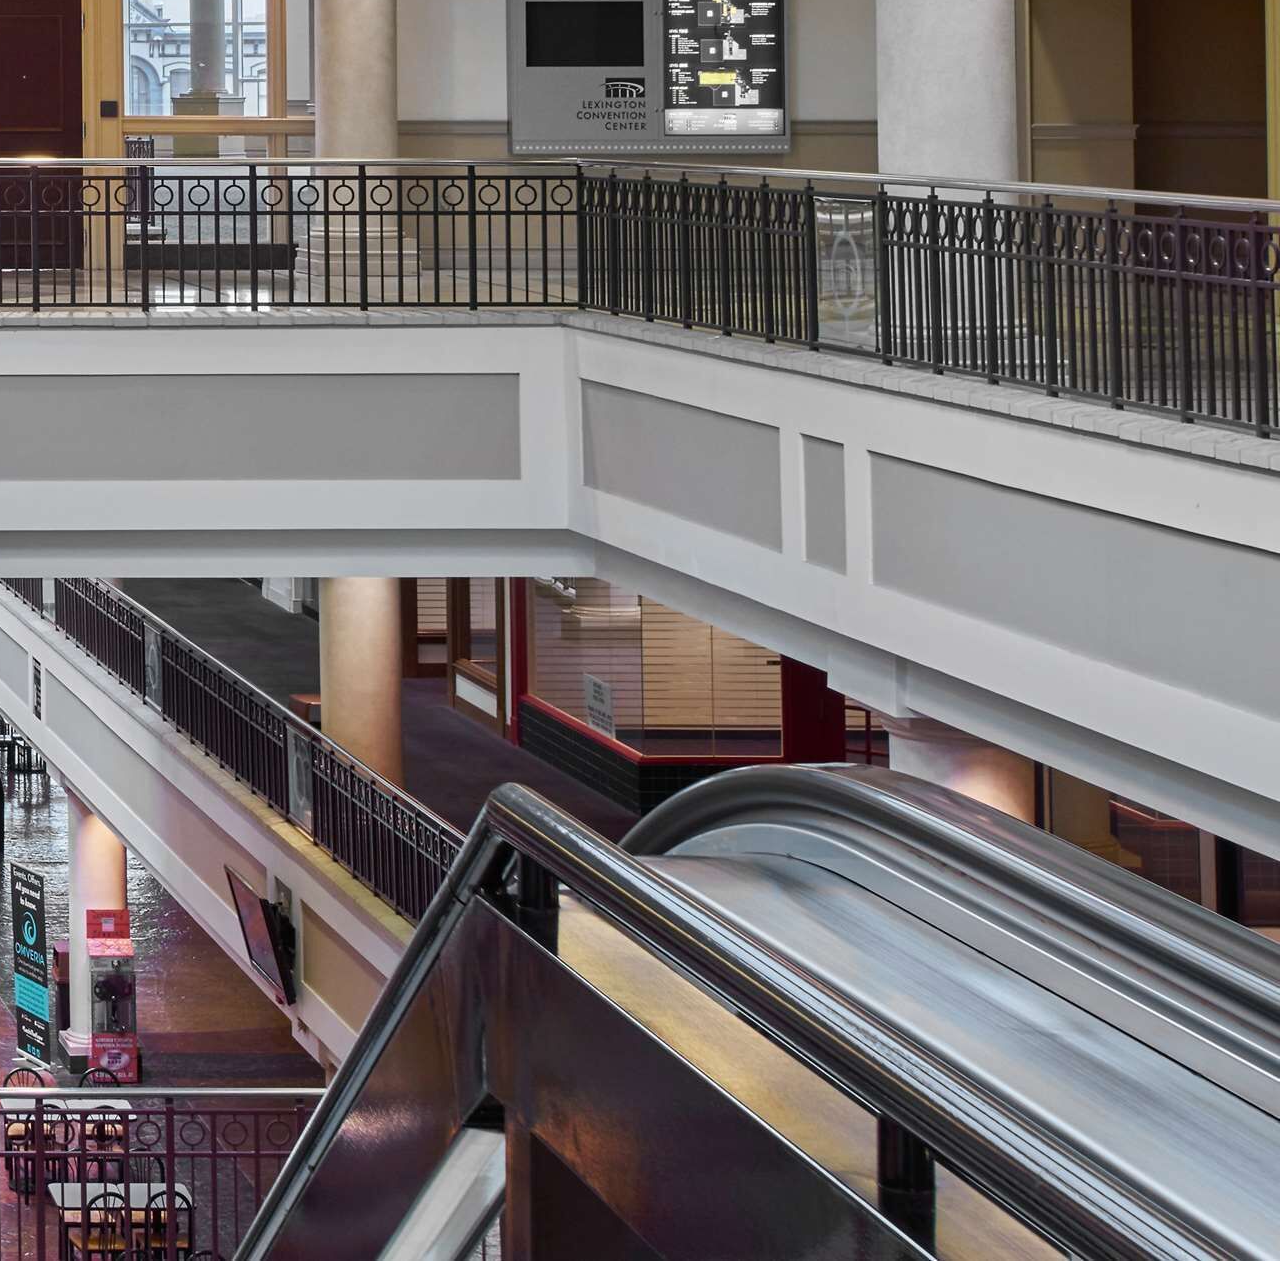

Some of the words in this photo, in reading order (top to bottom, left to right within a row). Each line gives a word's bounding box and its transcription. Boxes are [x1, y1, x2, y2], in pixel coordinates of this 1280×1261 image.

[582, 99, 647, 109] LEXINGTON
[576, 110, 647, 120] CONVENTION
[604, 121, 648, 131] CENTER
